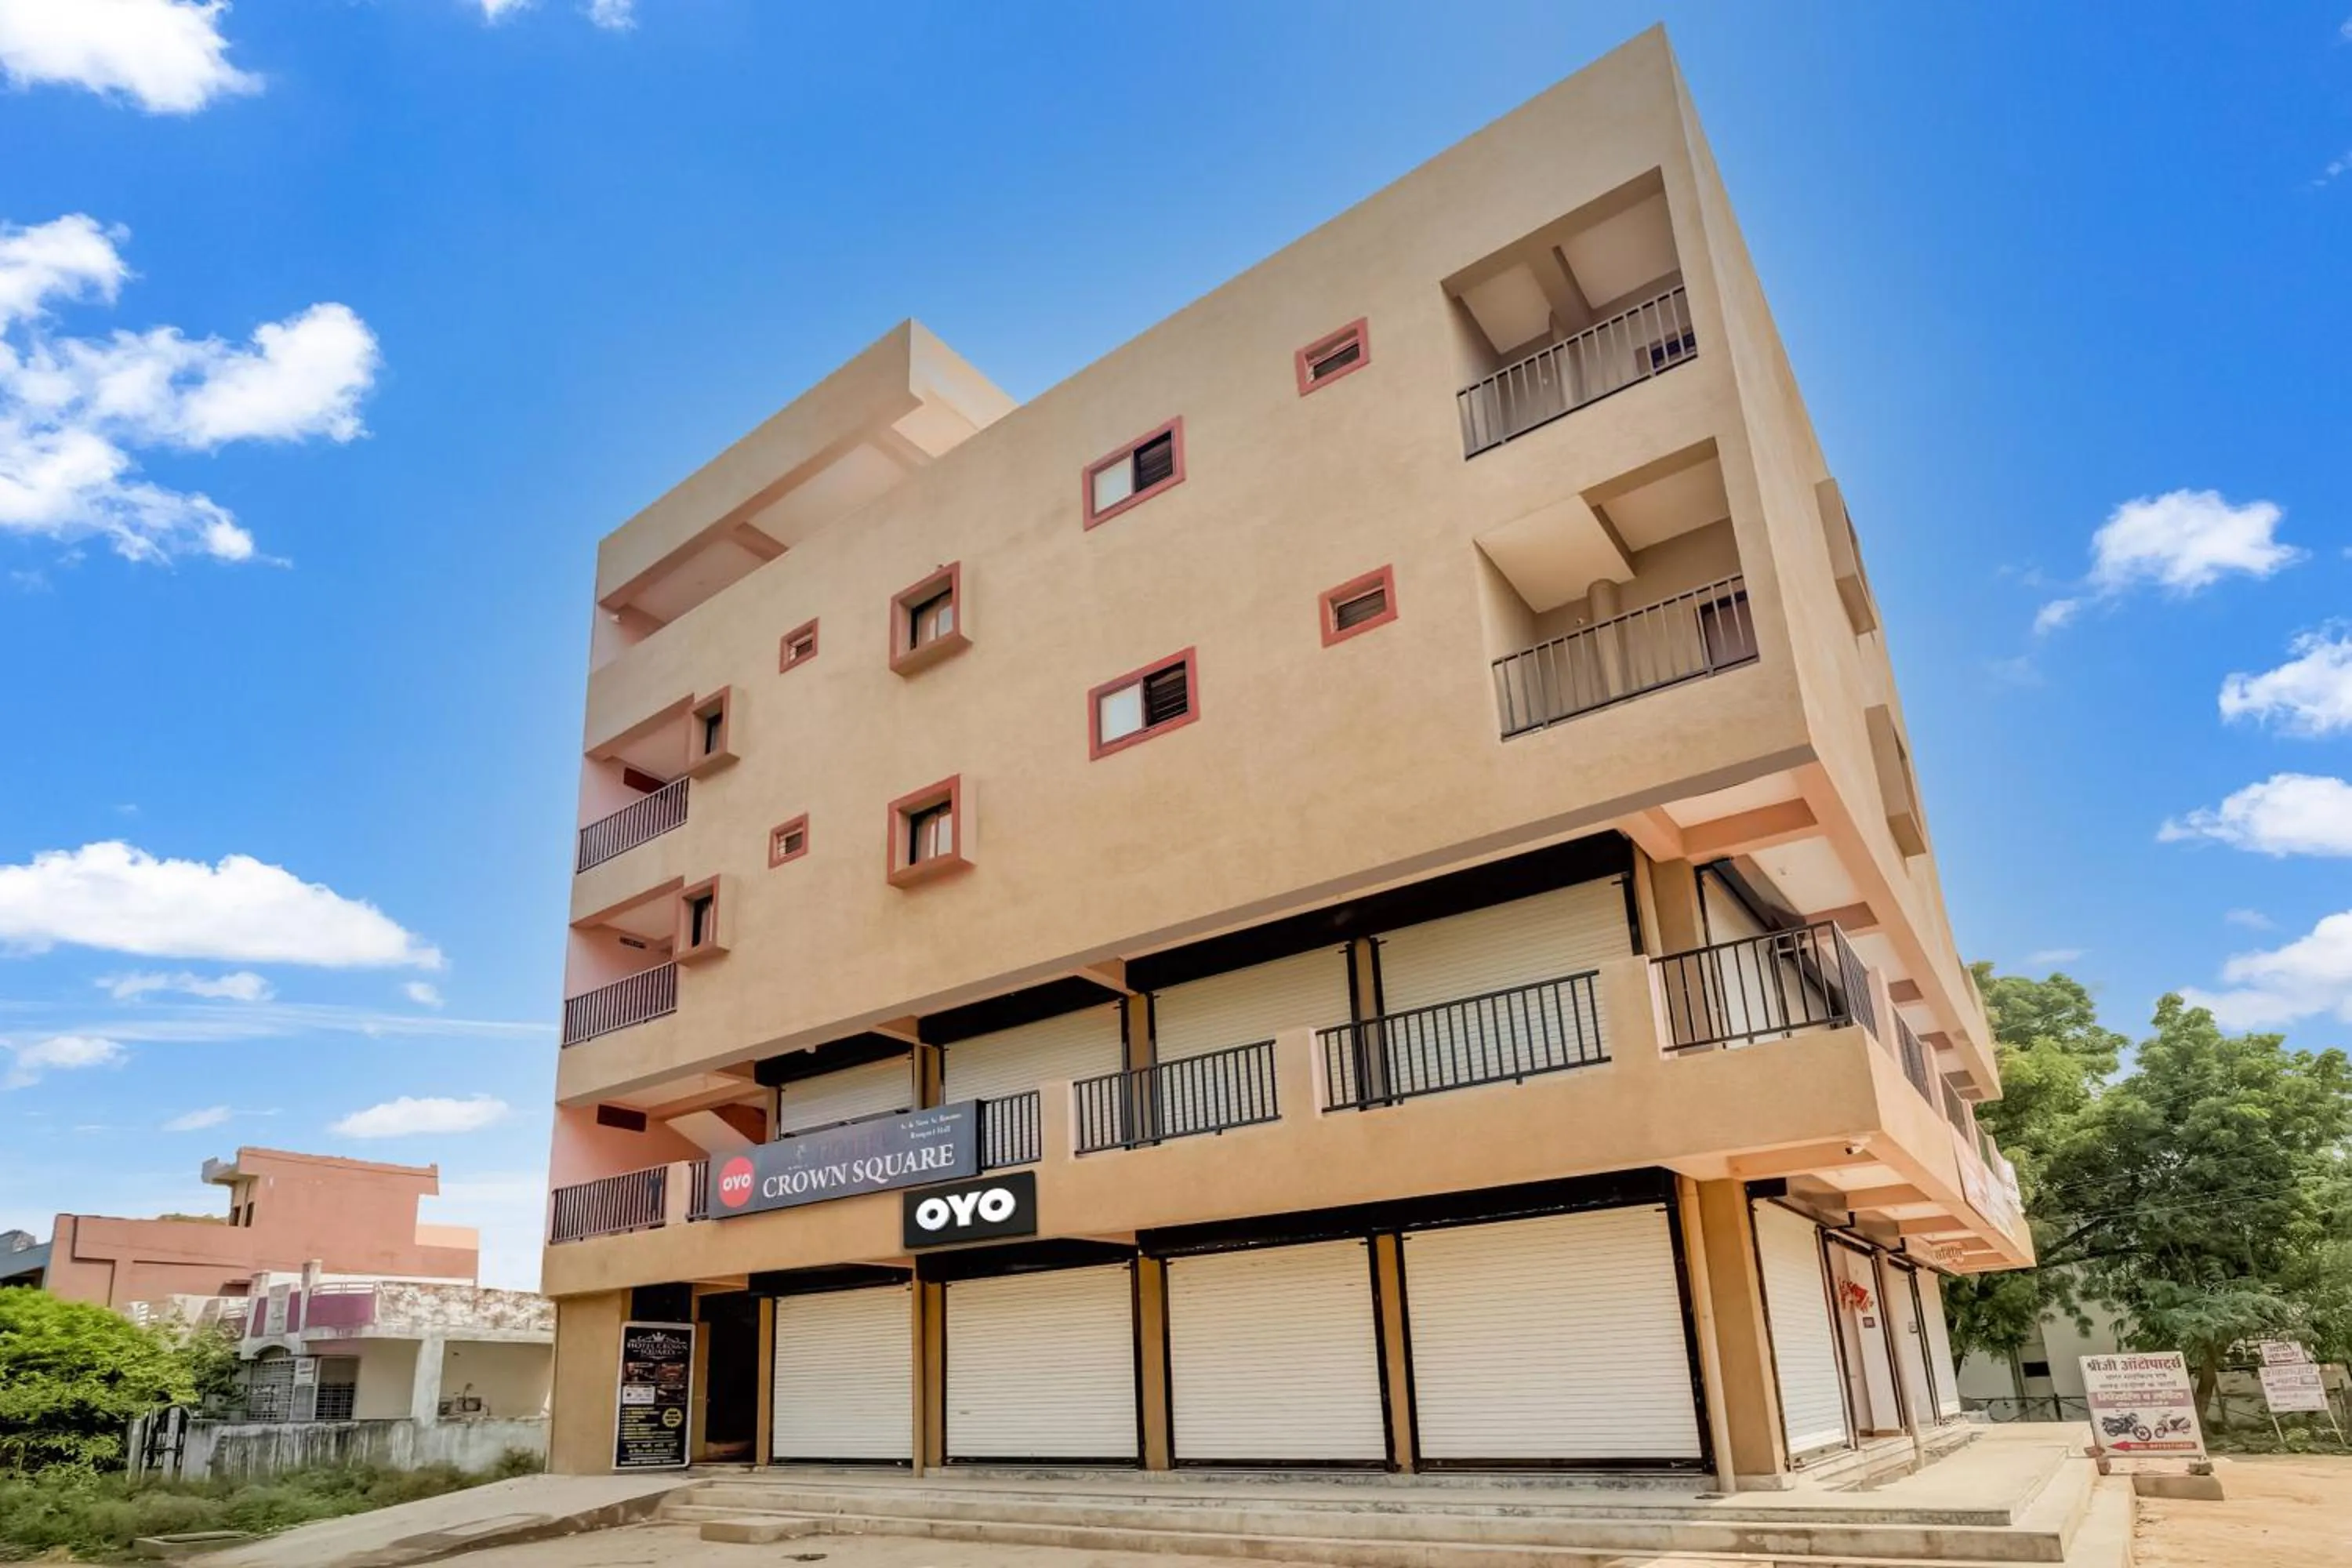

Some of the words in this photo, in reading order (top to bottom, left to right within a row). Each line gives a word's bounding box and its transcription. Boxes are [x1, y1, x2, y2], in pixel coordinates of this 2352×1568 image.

[722, 1172, 751, 1191] OYO
[762, 1162, 848, 1199] CROWN
[852, 1143, 955, 1185] SQUARE
[916, 1187, 1017, 1232] OYO
